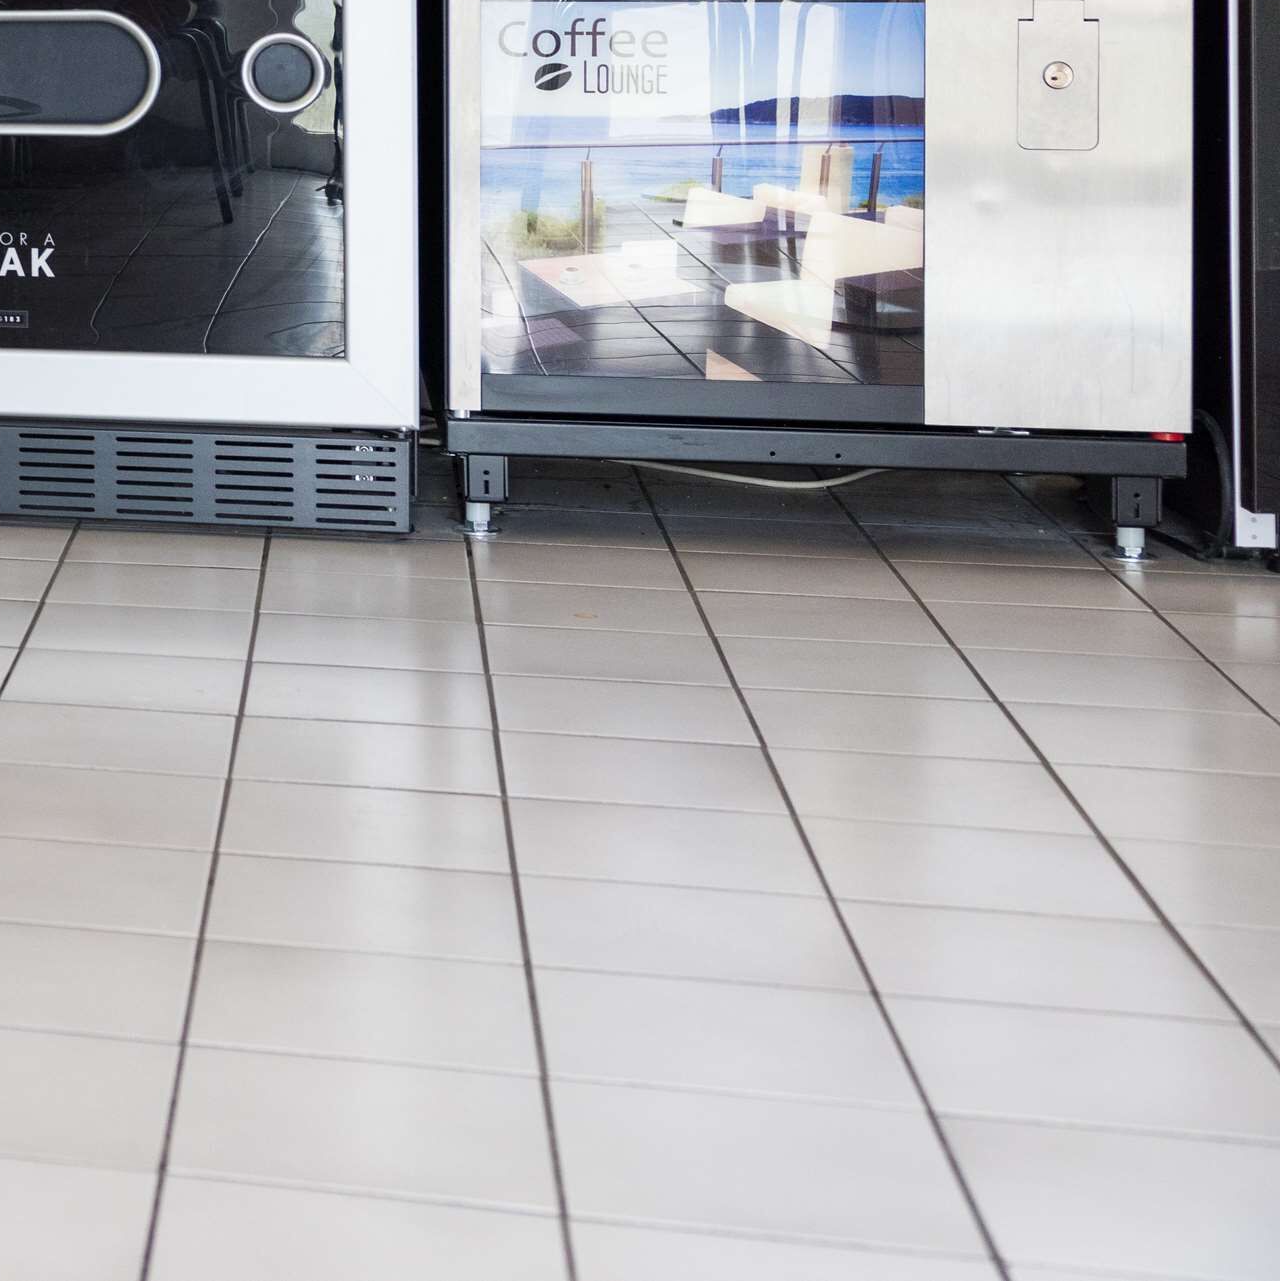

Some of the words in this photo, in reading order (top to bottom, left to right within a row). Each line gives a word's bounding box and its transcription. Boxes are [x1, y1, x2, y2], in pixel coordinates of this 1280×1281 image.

[498, 18, 669, 58] Coffee
[583, 60, 668, 94] LOUNGE
[44, 233, 55, 246] A
